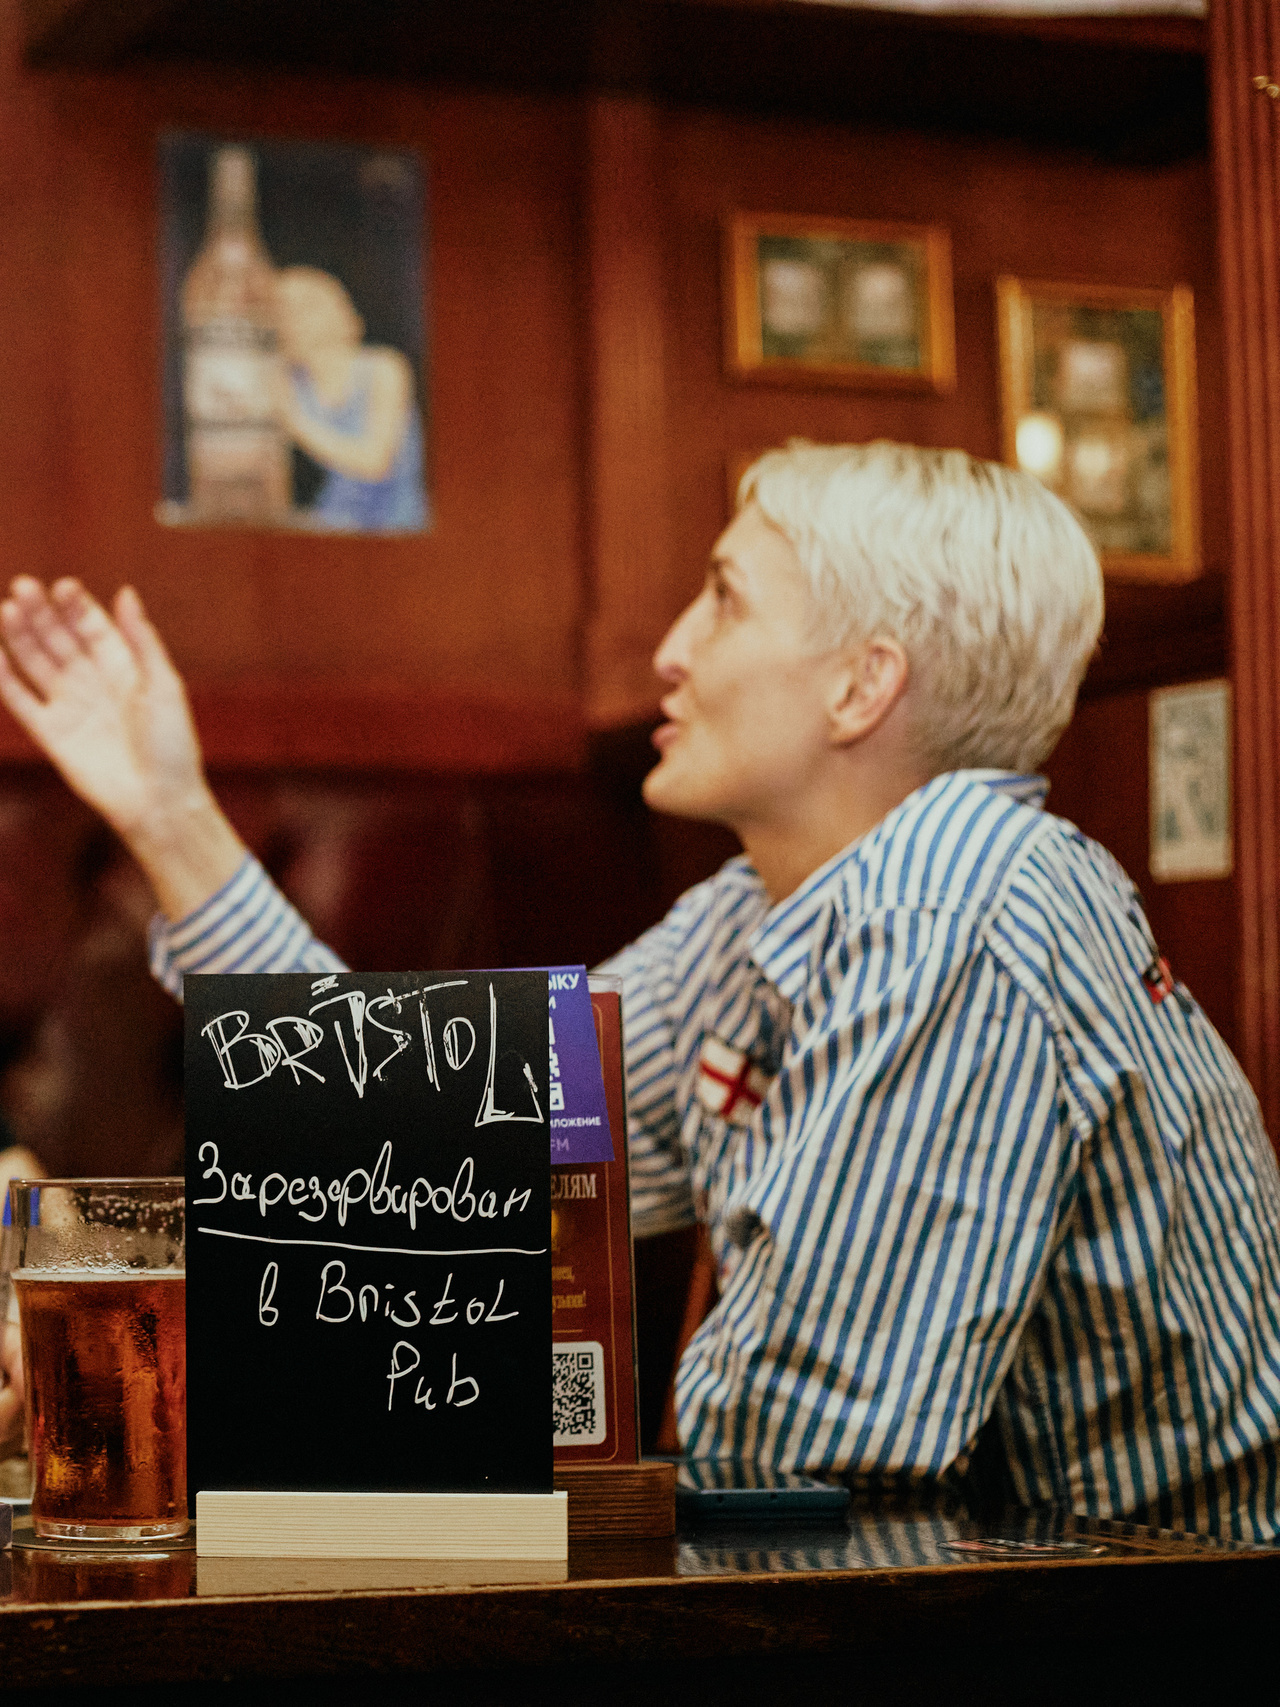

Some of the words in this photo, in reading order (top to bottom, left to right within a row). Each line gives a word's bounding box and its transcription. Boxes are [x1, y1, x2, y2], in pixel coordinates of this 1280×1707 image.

[200, 974, 545, 1128] BRISTOL
[192, 1140, 532, 1231] Зарезервирован
[386, 1340, 481, 1412] Pub
